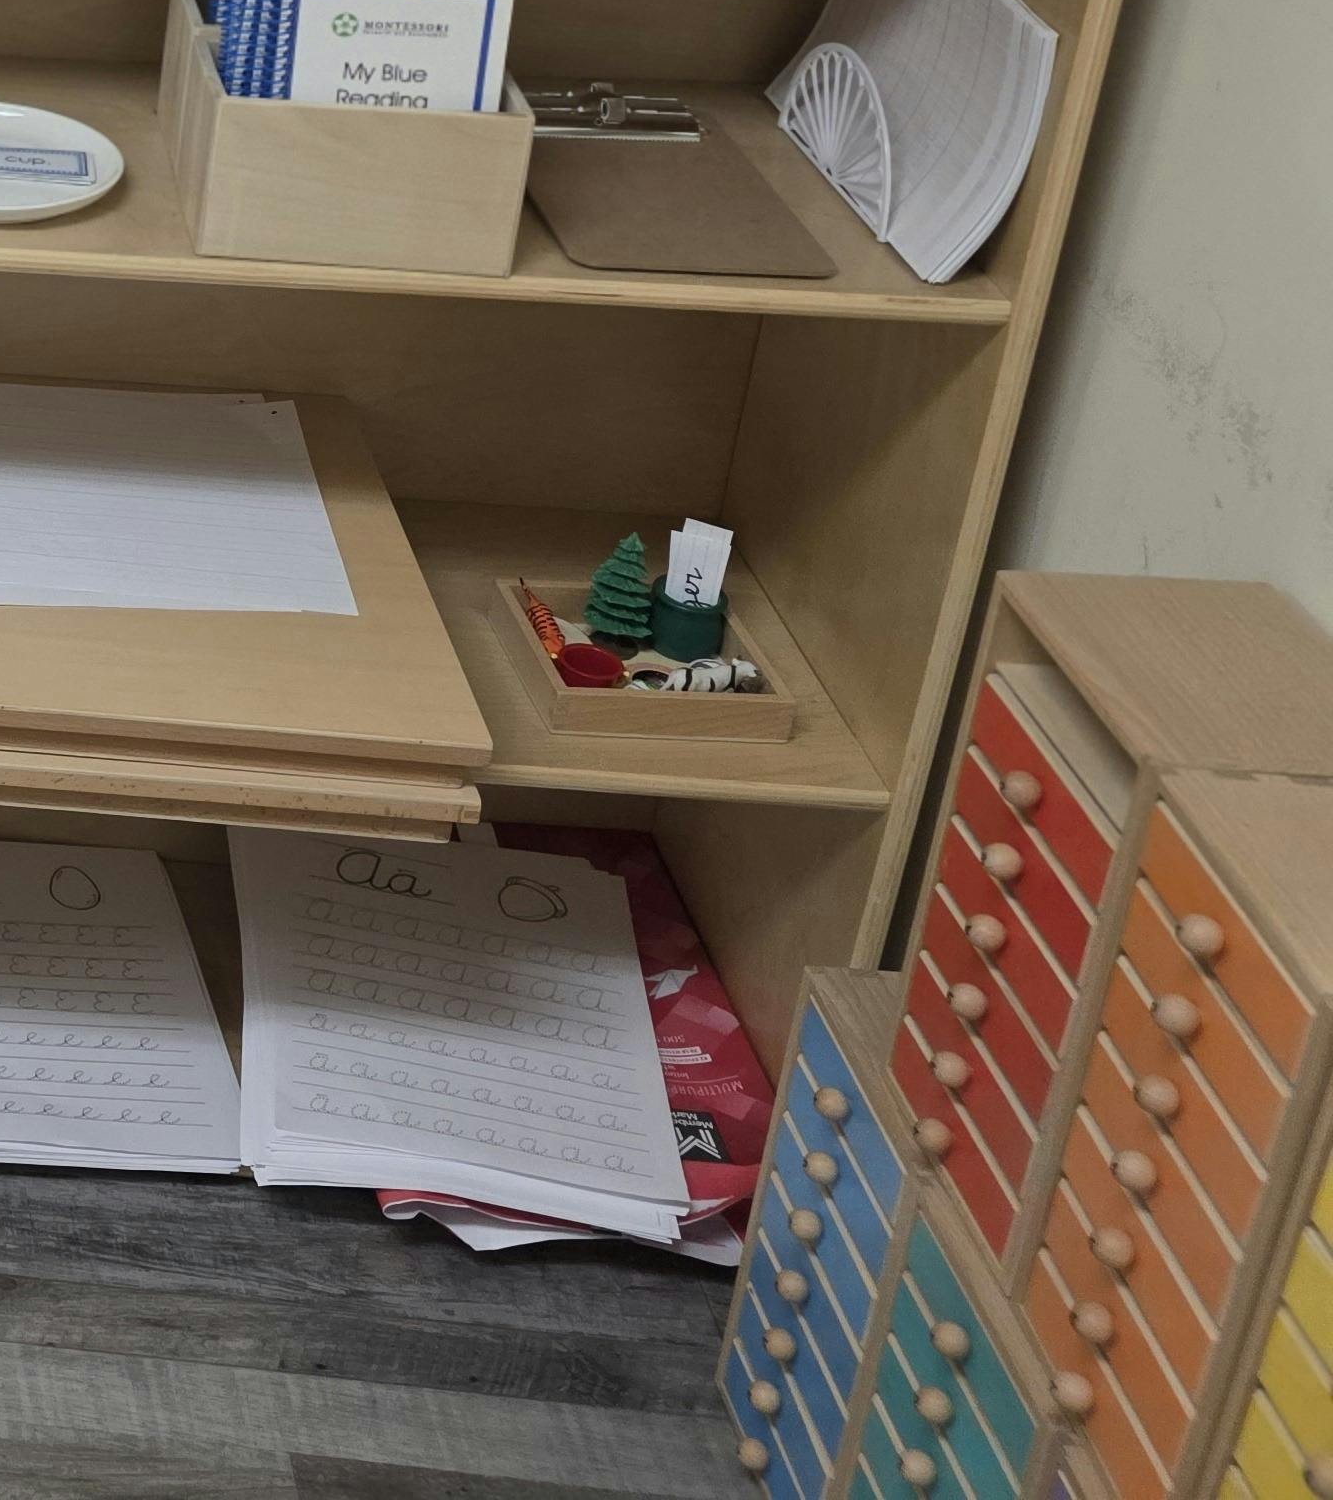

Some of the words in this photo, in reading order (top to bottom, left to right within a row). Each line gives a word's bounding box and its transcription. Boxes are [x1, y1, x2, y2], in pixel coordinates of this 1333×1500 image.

[364, 20, 449, 33] MONTESSORI
[342, 61, 376, 85] My
[381, 62, 429, 84] Blue
[4, 154, 52, 167] cup.
[334, 848, 433, 898] Aa
